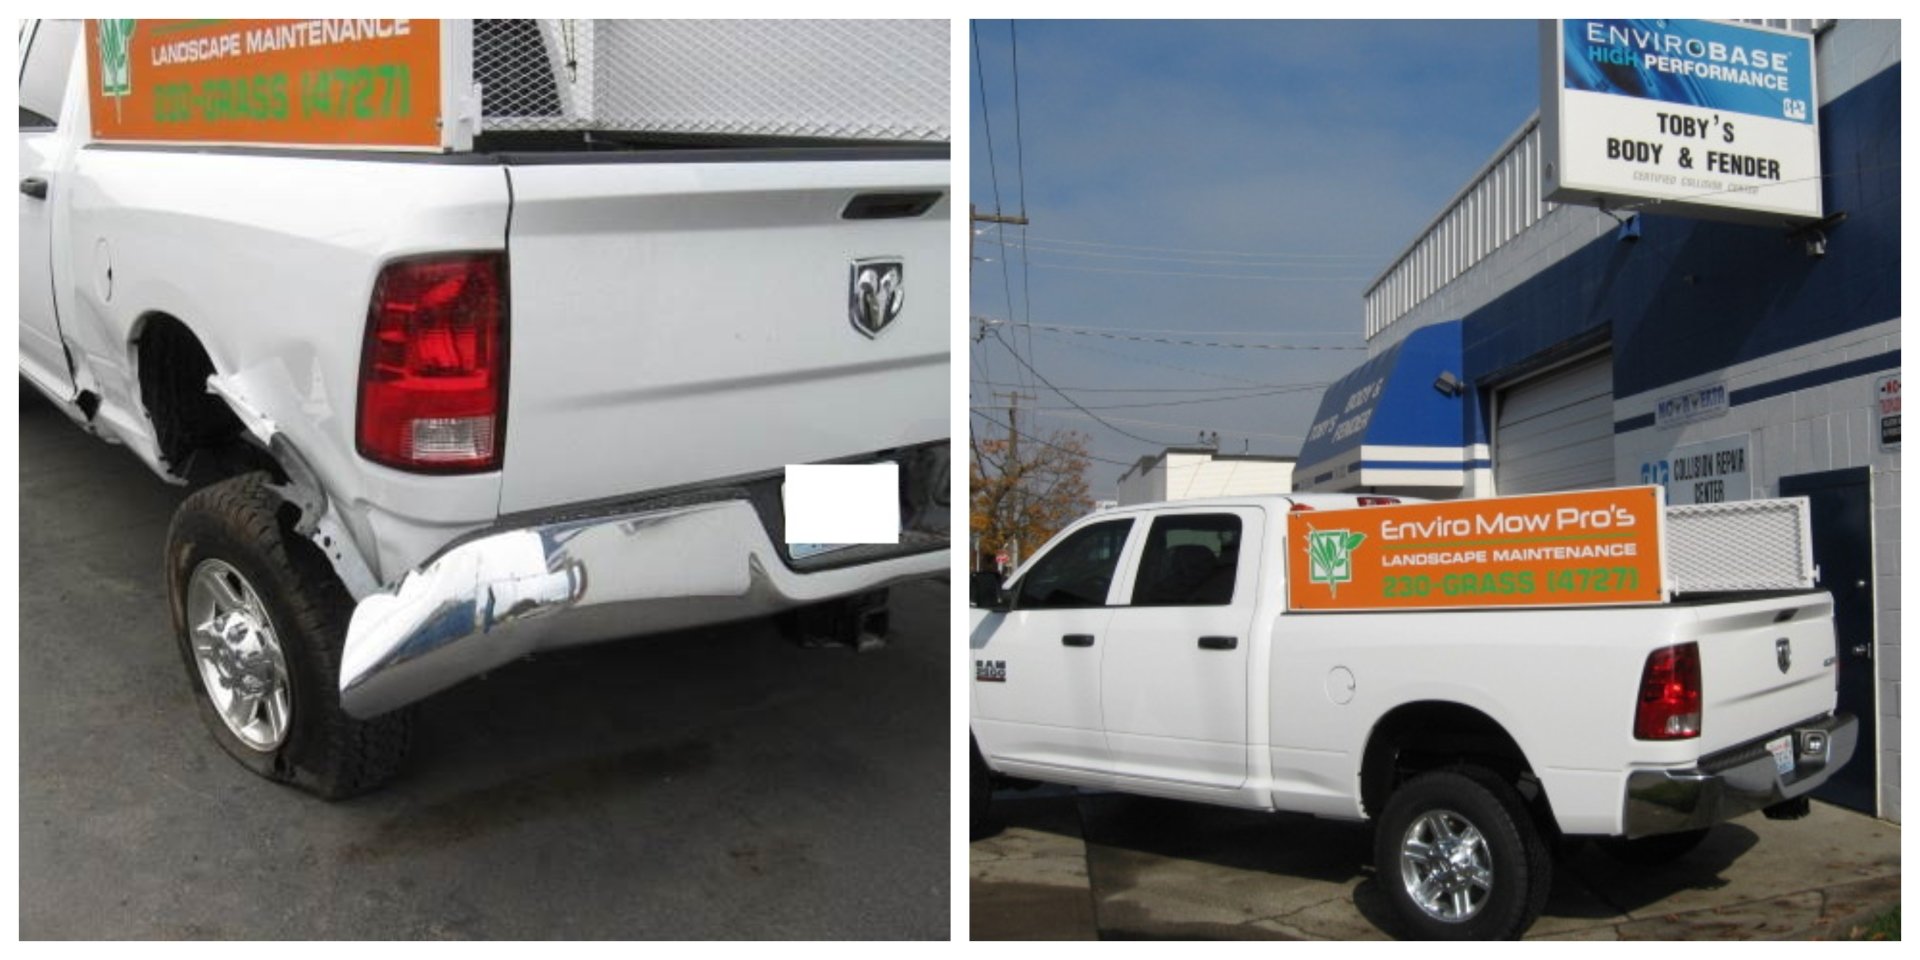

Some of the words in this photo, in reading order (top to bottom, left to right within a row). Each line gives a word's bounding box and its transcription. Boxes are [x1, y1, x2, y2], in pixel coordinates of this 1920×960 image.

[152, 33, 241, 66] LANDSCAPE
[246, 18, 411, 54] MAINTENANCE
[1586, 22, 1790, 73] ENVIROBASE
[1588, 45, 1639, 67] HIGH
[1644, 55, 1790, 91] PERFORMANCE
[1657, 112, 1735, 144] TOBY'S
[1606, 138, 1664, 165] BODY
[1678, 147, 1693, 169] &
[1706, 151, 1781, 181] FENDER
[1673, 453, 1714, 481] COLLISION
[1715, 448, 1745, 475] REPAIR
[1694, 479, 1725, 504] CENTER
[1380, 518, 1472, 542] Enviro
[1476, 513, 1551, 536] Mow
[1557, 502, 1637, 532] Pro's
[1381, 550, 1488, 568] LANDSCAPE
[1493, 543, 1637, 563] MAINTENANCE
[1382, 570, 1535, 599] 230-GRASS
[1547, 567, 1638, 594] (4727)
